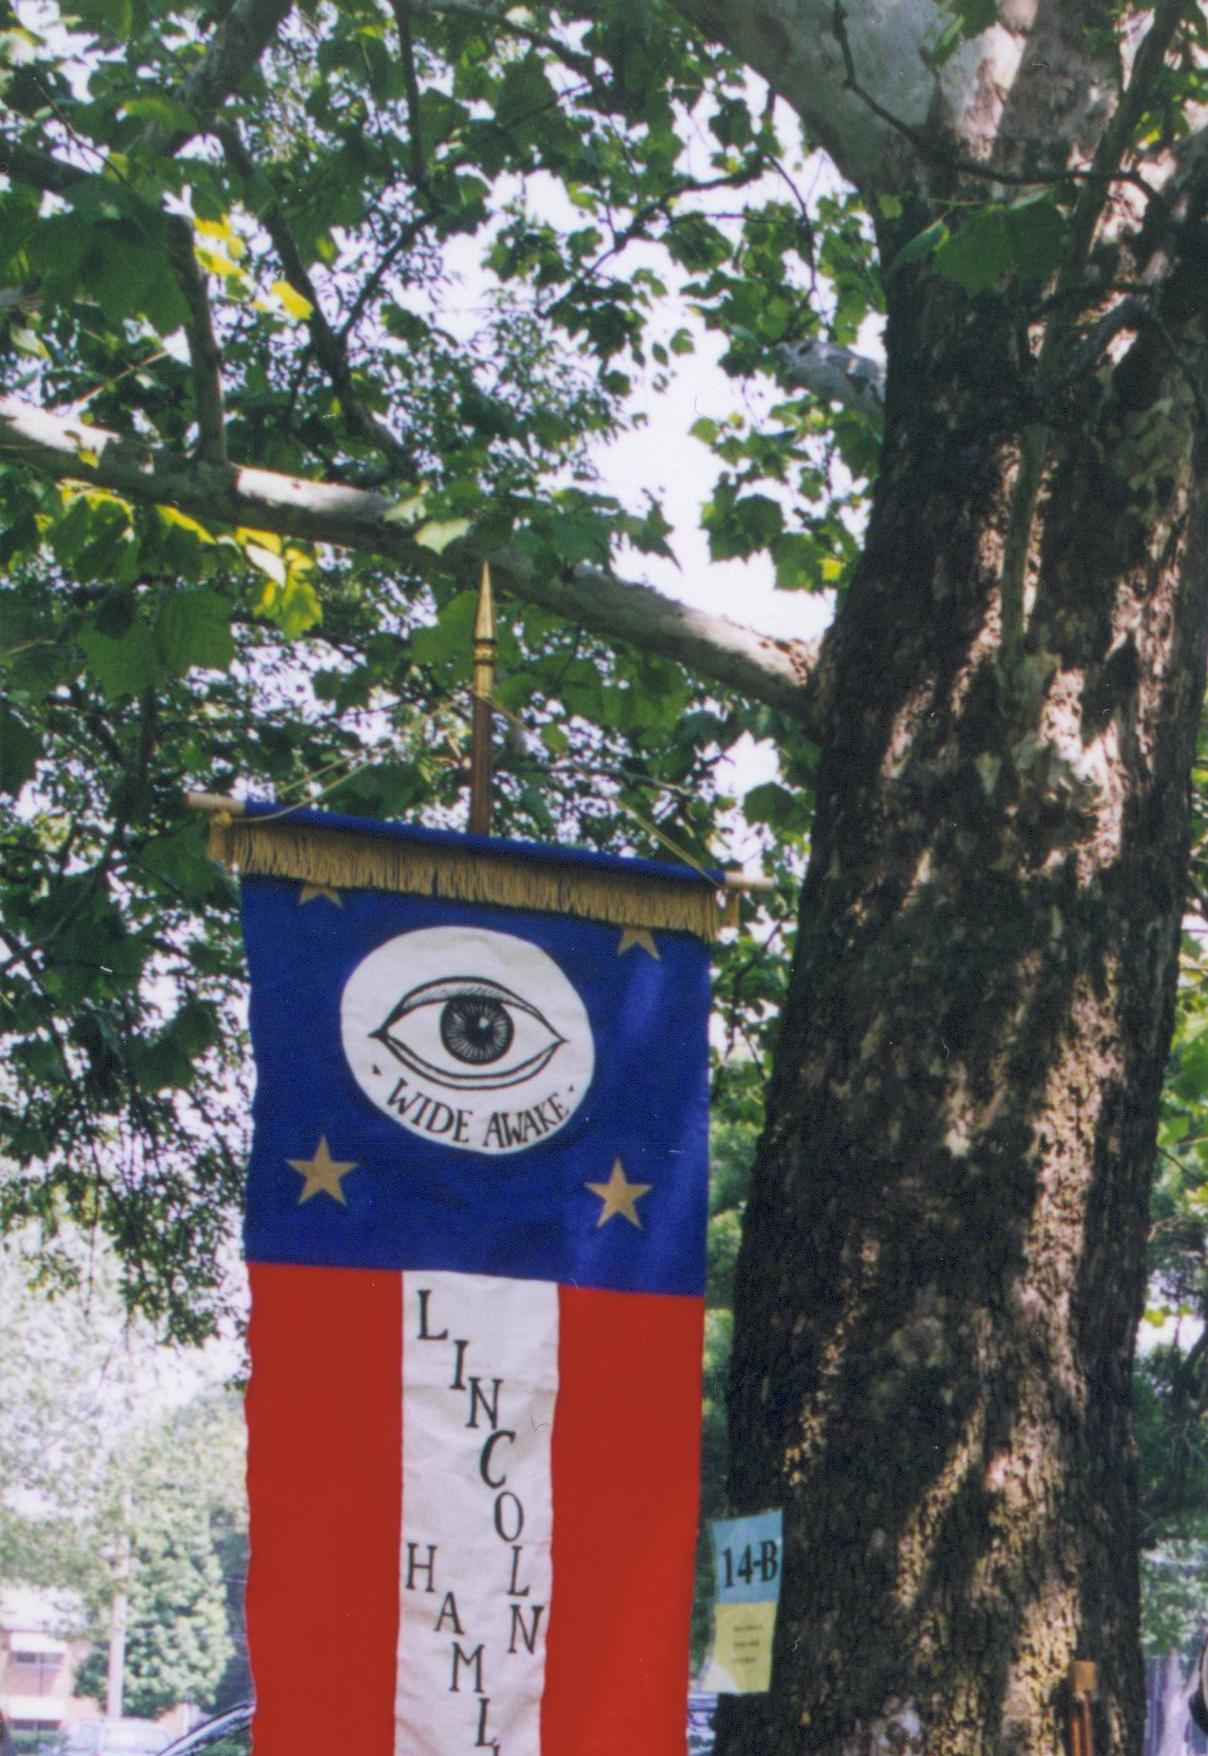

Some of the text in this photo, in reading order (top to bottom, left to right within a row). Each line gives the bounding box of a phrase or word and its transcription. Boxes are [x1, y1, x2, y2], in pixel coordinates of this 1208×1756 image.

[387, 1077, 570, 1148] WIDE AWAKE
[417, 1289, 544, 1655] LINCOLN
[721, 1538, 779, 1589] 14-B
